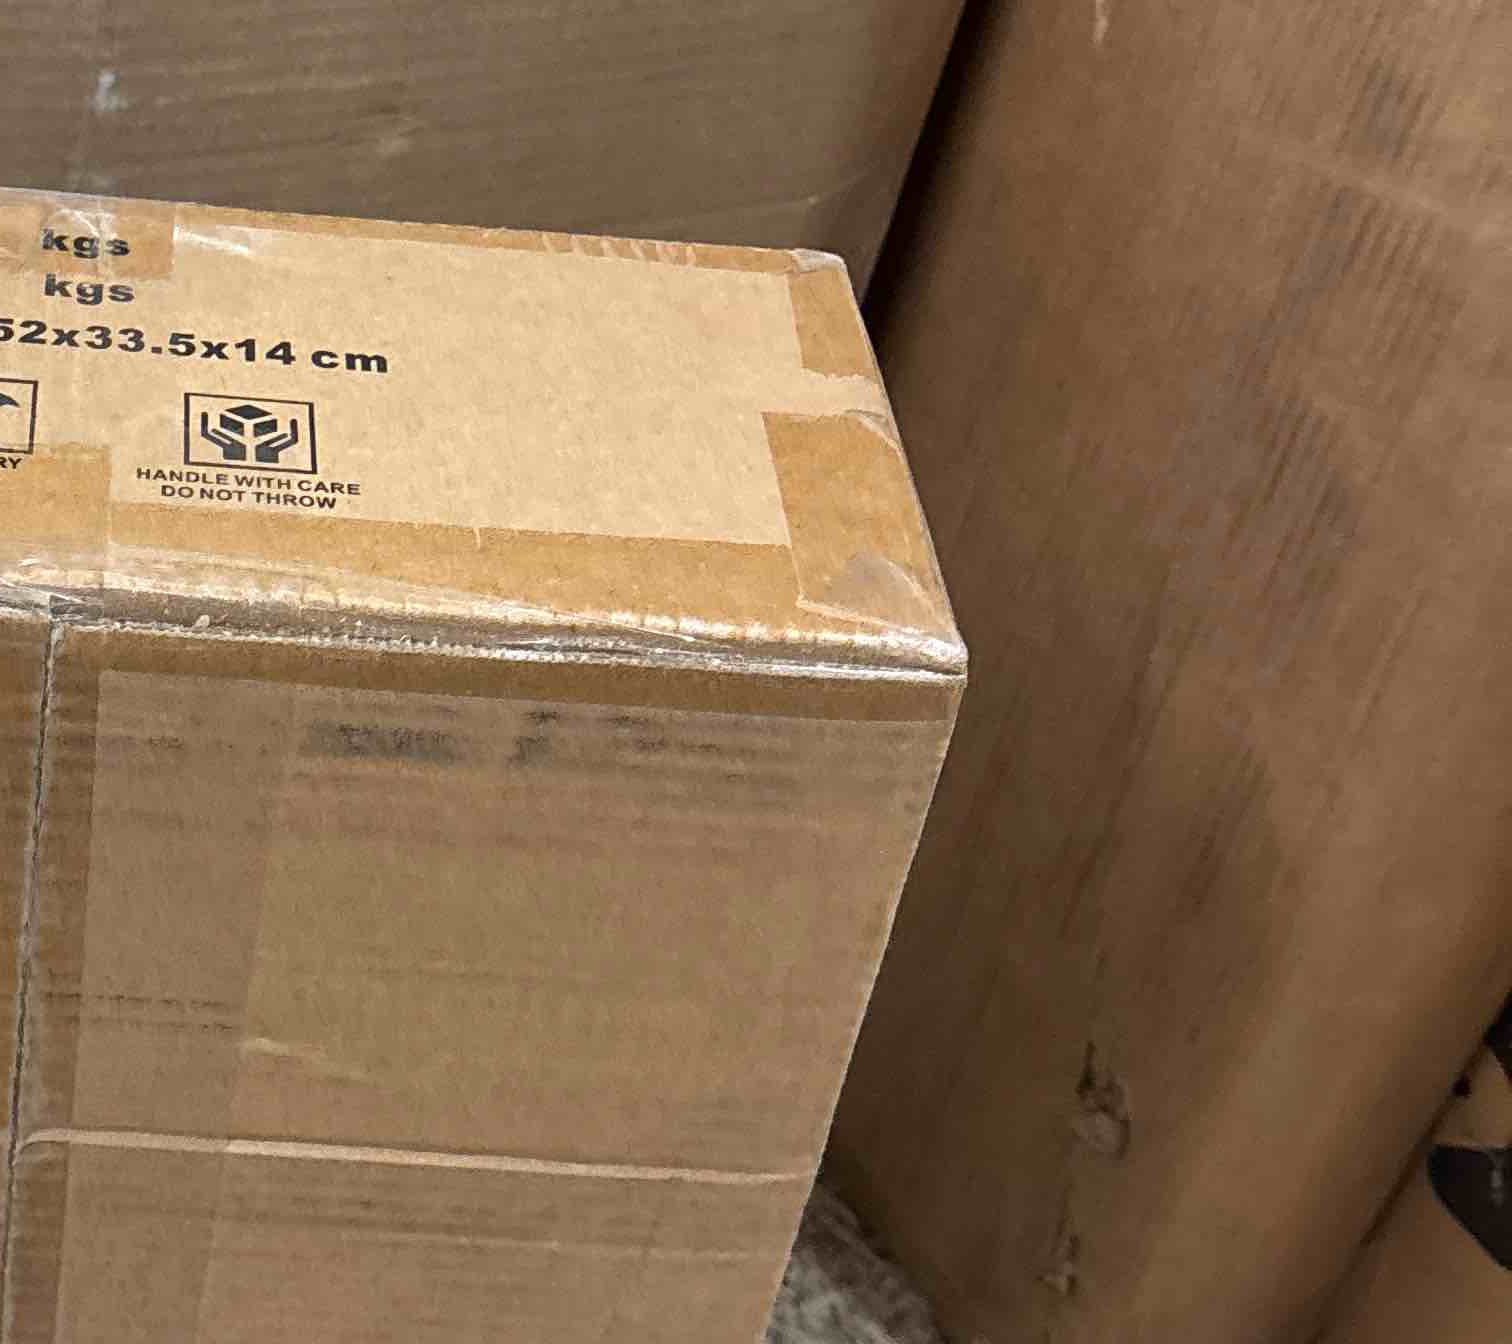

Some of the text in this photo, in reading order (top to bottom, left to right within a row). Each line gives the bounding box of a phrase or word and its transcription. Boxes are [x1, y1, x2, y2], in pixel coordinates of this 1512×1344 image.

[41, 228, 130, 259] kgs
[43, 273, 136, 306] kgs
[311, 349, 389, 374] cm
[137, 467, 361, 495] HANDLE WITH CARE
[161, 485, 337, 509] DO NOT THROW
